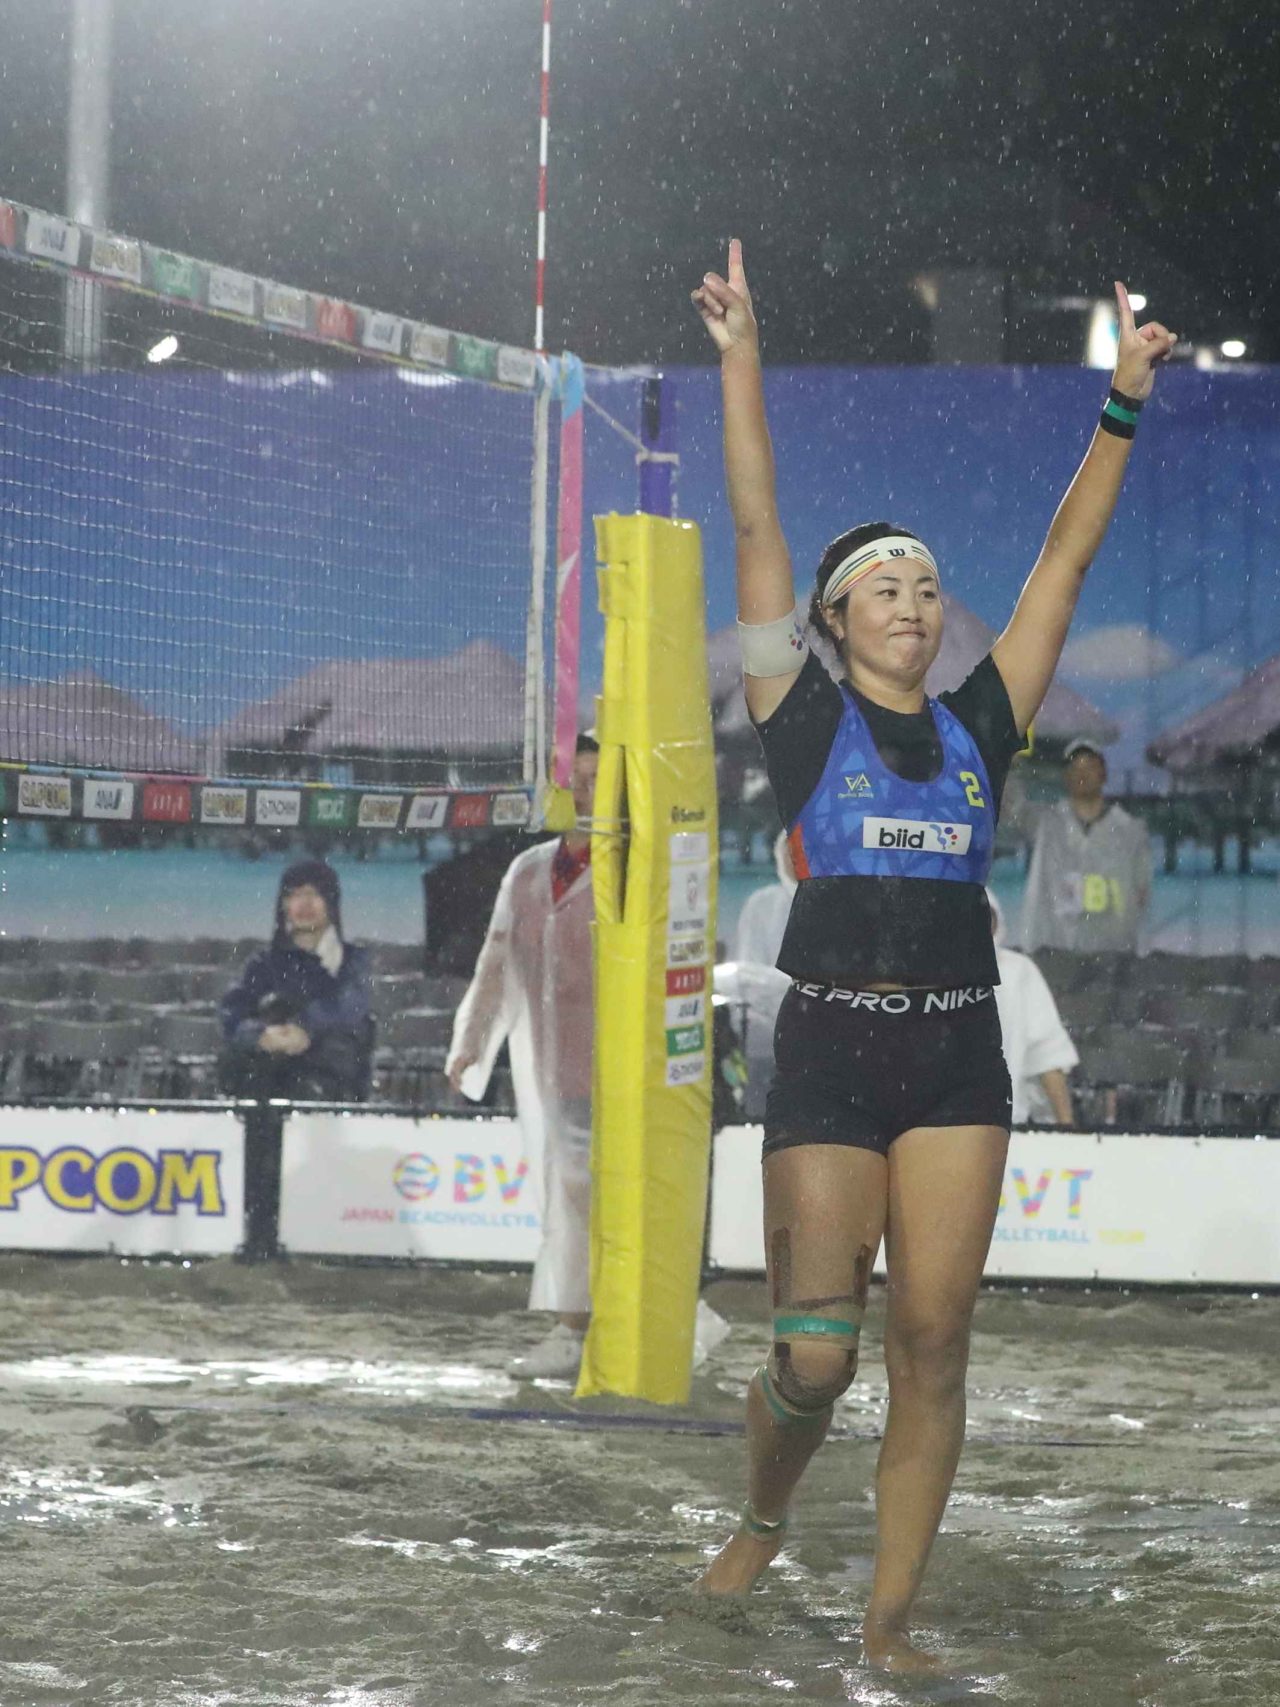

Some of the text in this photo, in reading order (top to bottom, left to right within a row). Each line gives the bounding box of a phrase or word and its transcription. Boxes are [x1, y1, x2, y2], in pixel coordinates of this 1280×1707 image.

[960, 771, 985, 808] 2
[879, 827, 925, 849] biid
[825, 987, 911, 1014] PRO
[923, 985, 992, 1013] NIKE
[0, 1145, 225, 1216] PCOM
[998, 1168, 1093, 1219] VT
